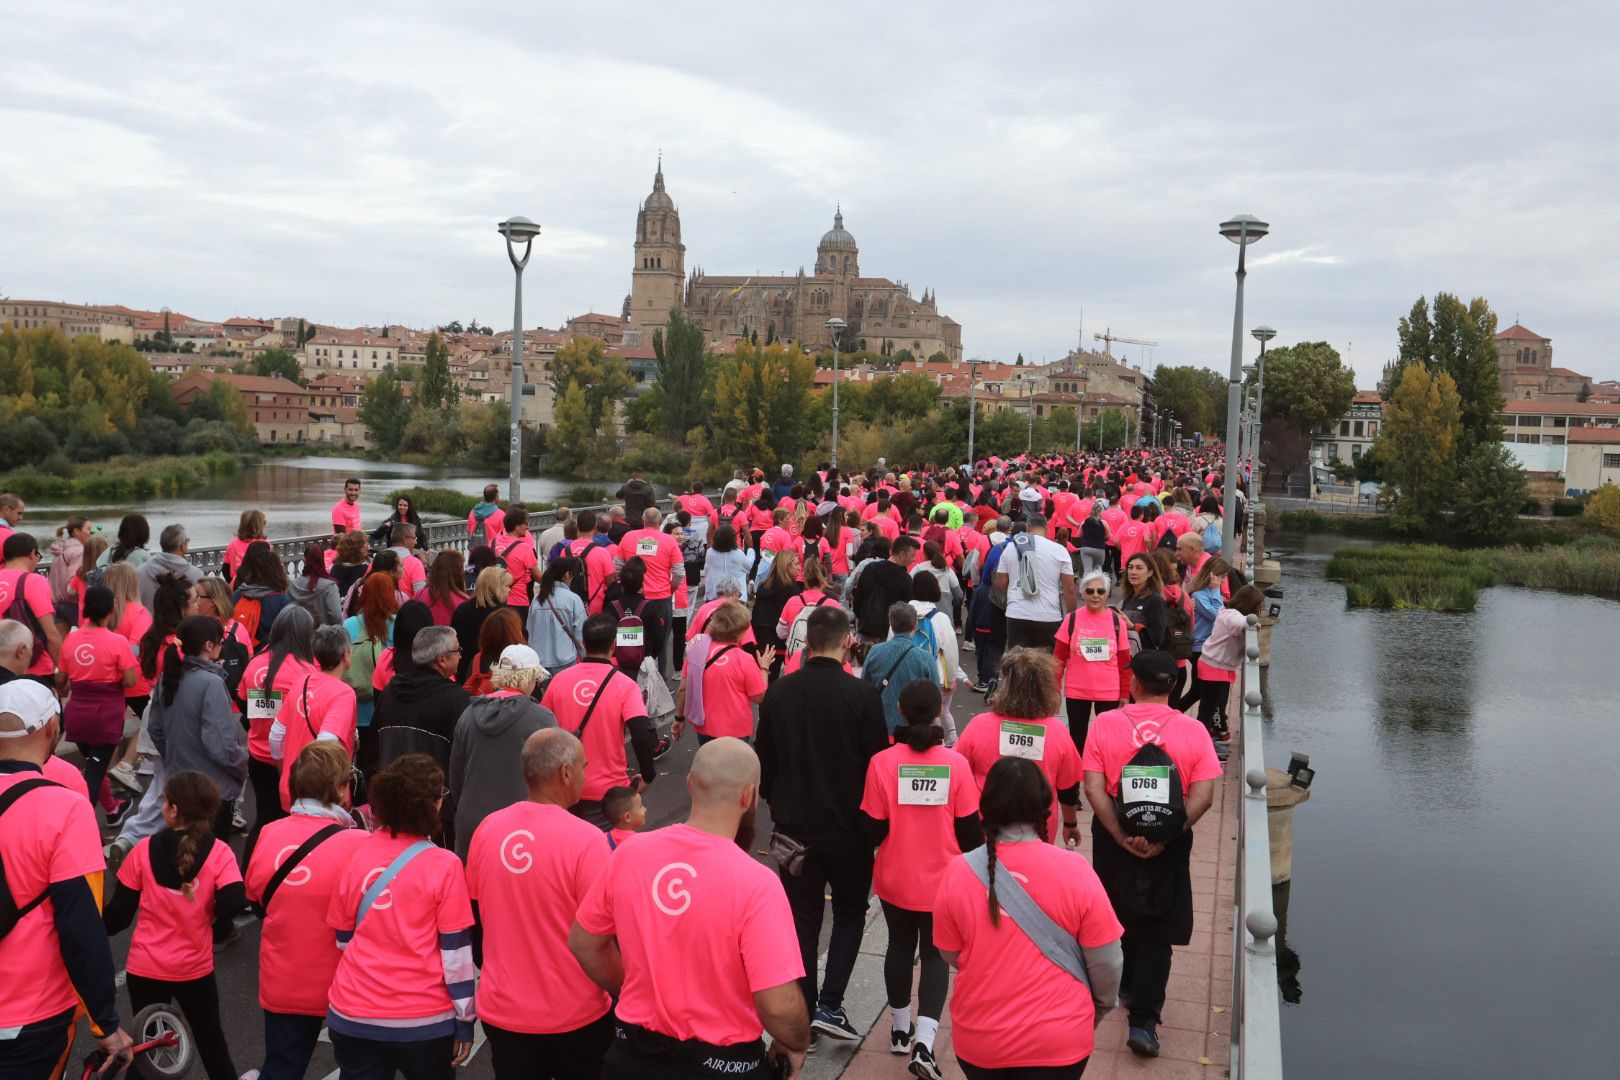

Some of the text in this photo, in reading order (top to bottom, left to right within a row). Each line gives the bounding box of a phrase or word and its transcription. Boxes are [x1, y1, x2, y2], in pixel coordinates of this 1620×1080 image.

[256, 700, 275, 709] 4560
[1009, 734, 1033, 747] 6769
[911, 779, 937, 791] 6772
[1131, 778, 1157, 789] 6768
[703, 1057, 760, 1073] AIR JORDAN
